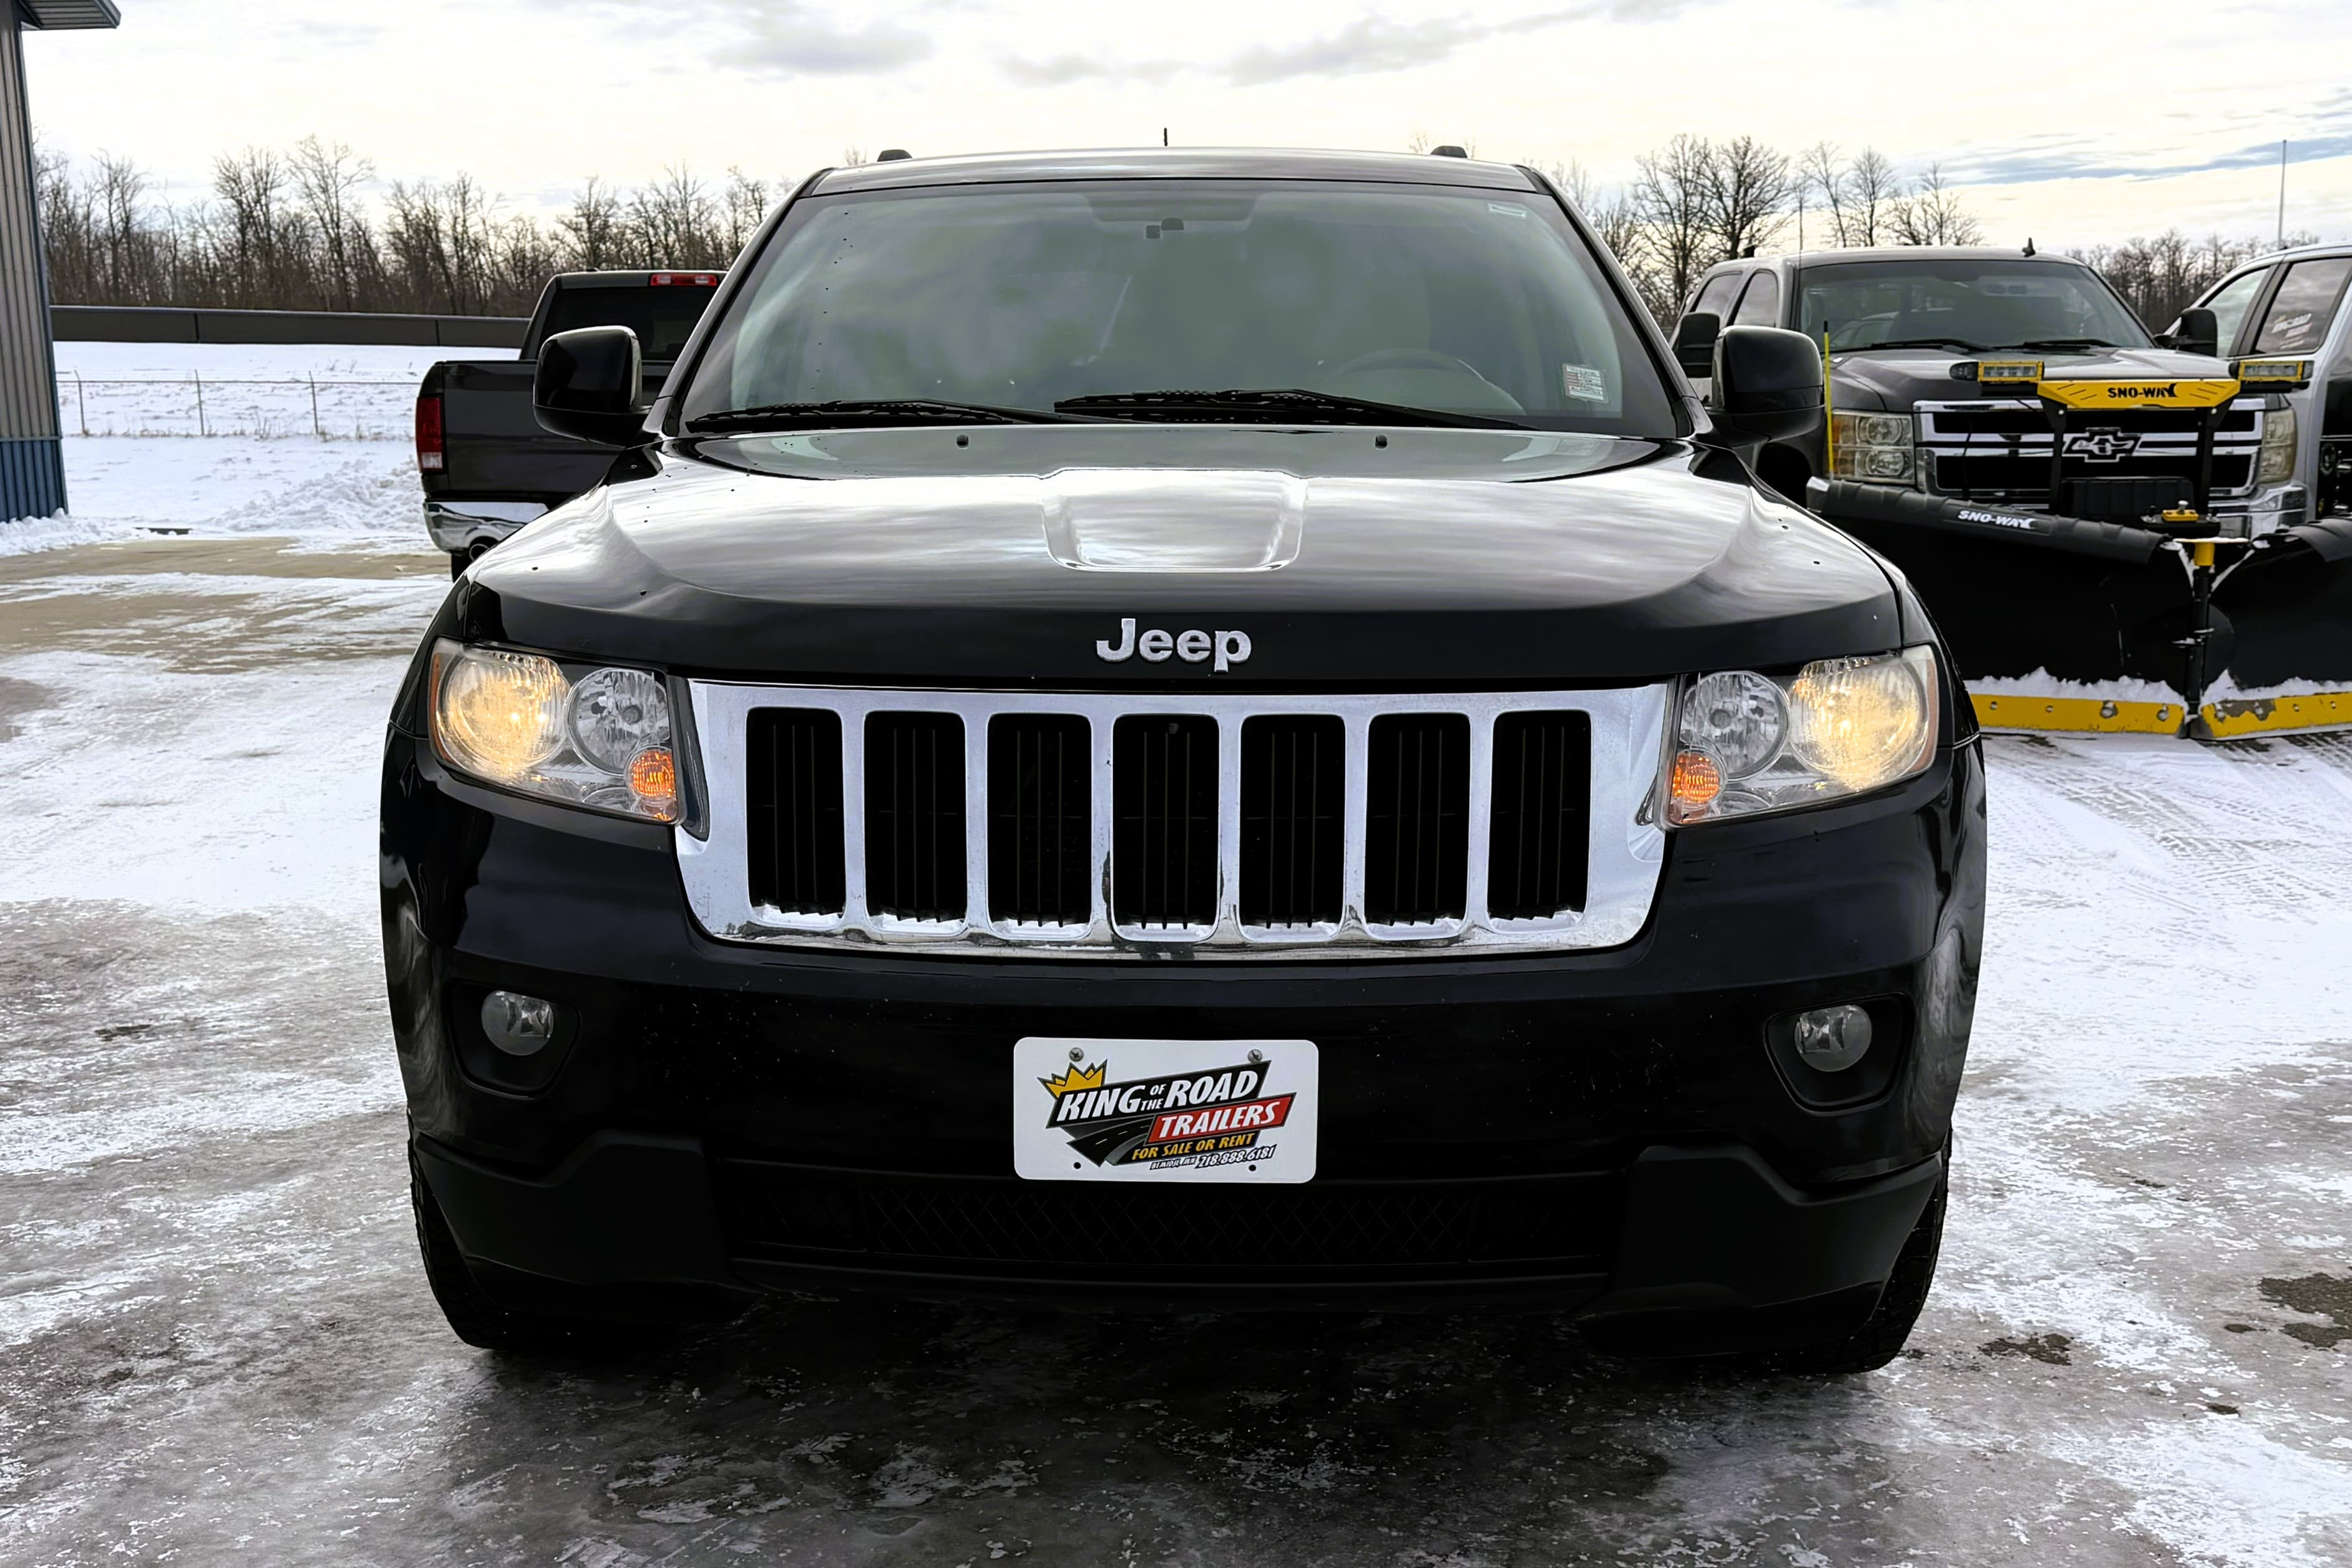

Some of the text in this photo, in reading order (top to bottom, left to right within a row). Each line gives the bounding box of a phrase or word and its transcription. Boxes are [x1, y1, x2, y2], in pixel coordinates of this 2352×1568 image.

[2107, 383, 2178, 398] SNO-WAY
[1958, 510, 2036, 529] SNO-WAY
[1096, 618, 1252, 672] Jeep
[1150, 1083, 1166, 1095] OF
[1164, 1070, 1258, 1108] ROAD
[1056, 1085, 1146, 1122] KING
[1141, 1098, 1164, 1111] THE
[1159, 1101, 1280, 1138] TRAILERS
[1132, 1133, 1255, 1160] FOR SALE OR RENT
[1198, 1147, 1275, 1168] 218.888.6181
